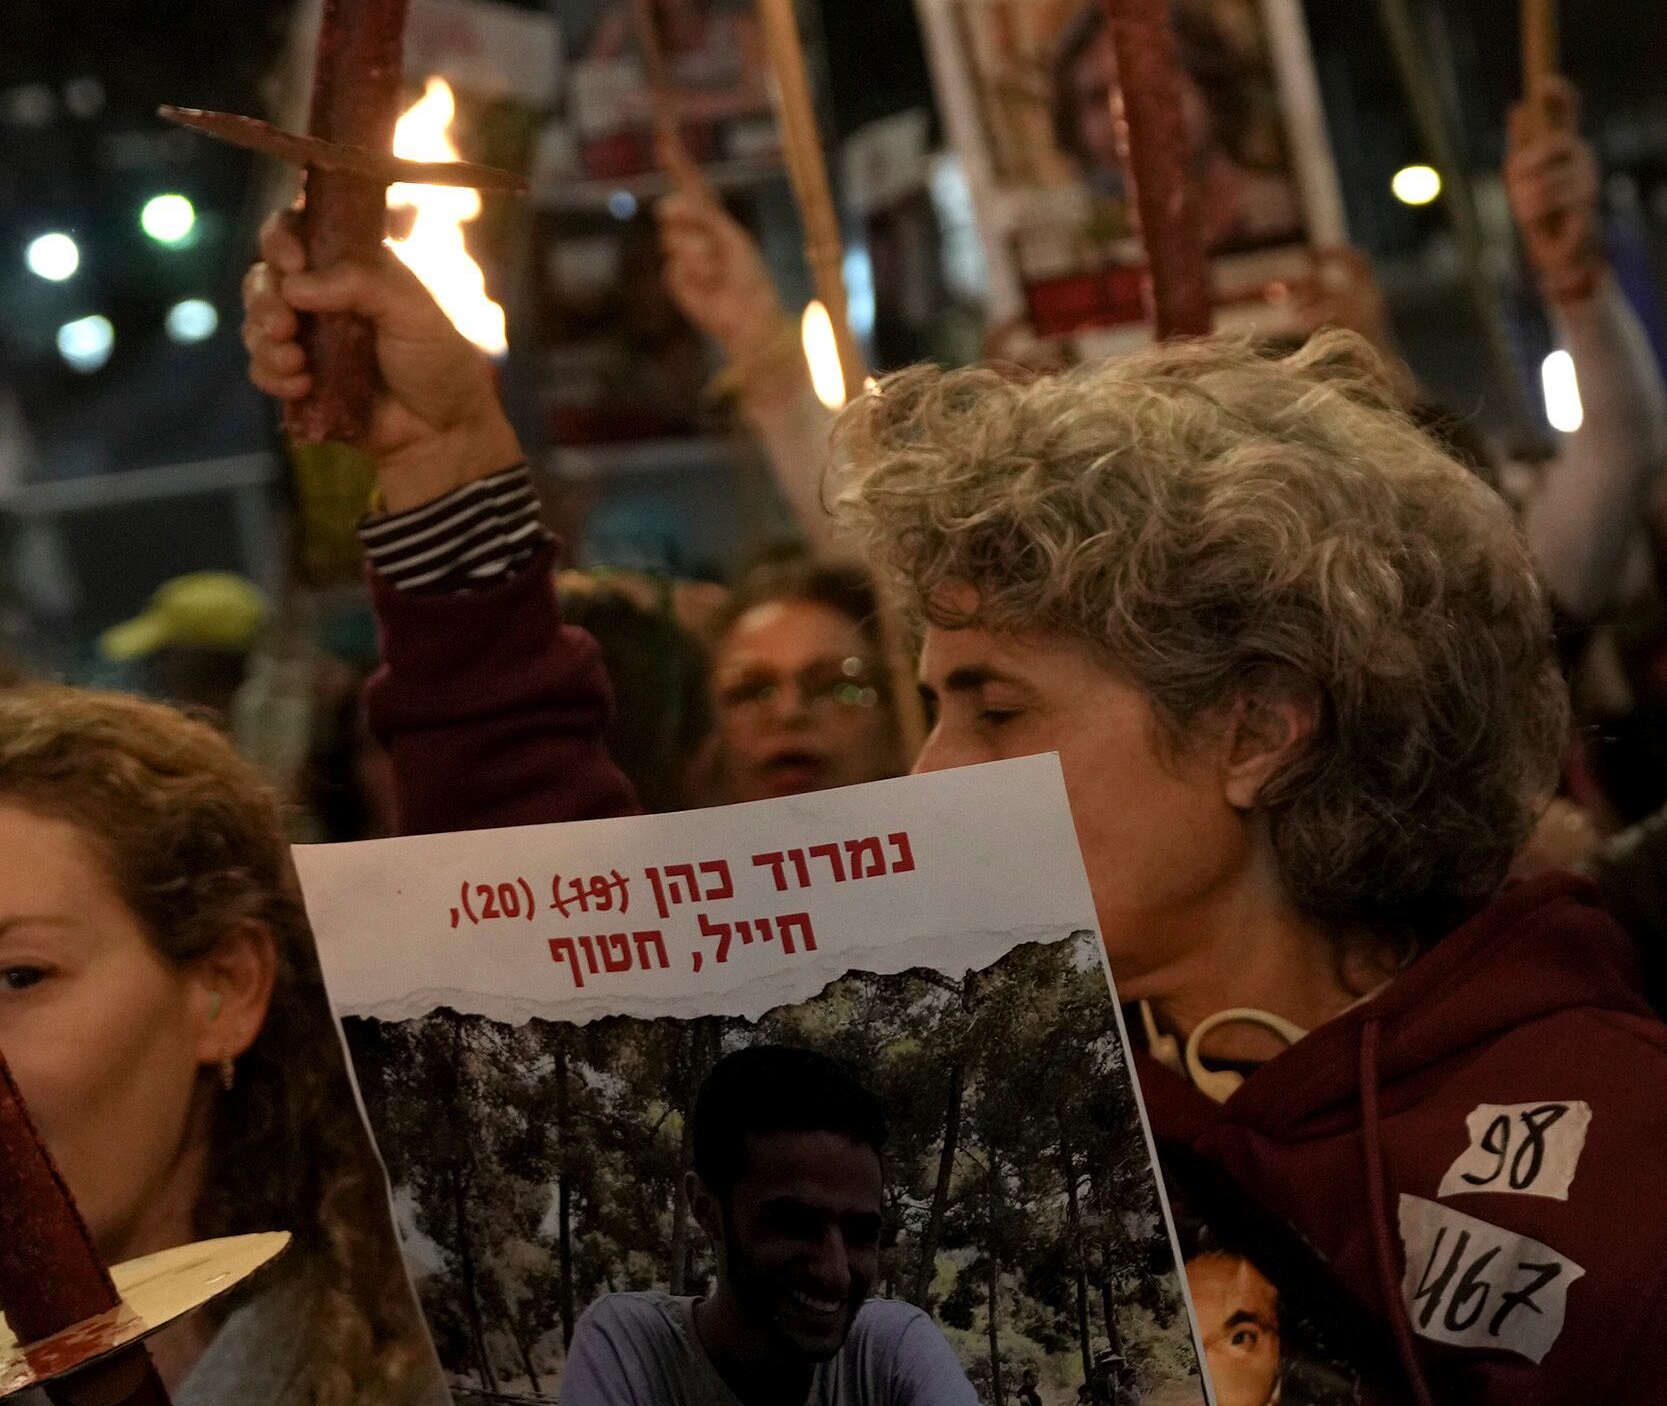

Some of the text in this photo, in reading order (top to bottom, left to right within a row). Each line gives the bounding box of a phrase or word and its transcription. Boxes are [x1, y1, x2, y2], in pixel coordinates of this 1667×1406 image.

[645, 859, 734, 919] כהן
[751, 831, 916, 892] נמרוד
[450, 876, 536, 929] (20),
[548, 911, 818, 988] חייל, חטוף
[1460, 1103, 1570, 1190] 98
[1413, 1226, 1562, 1338] 467
